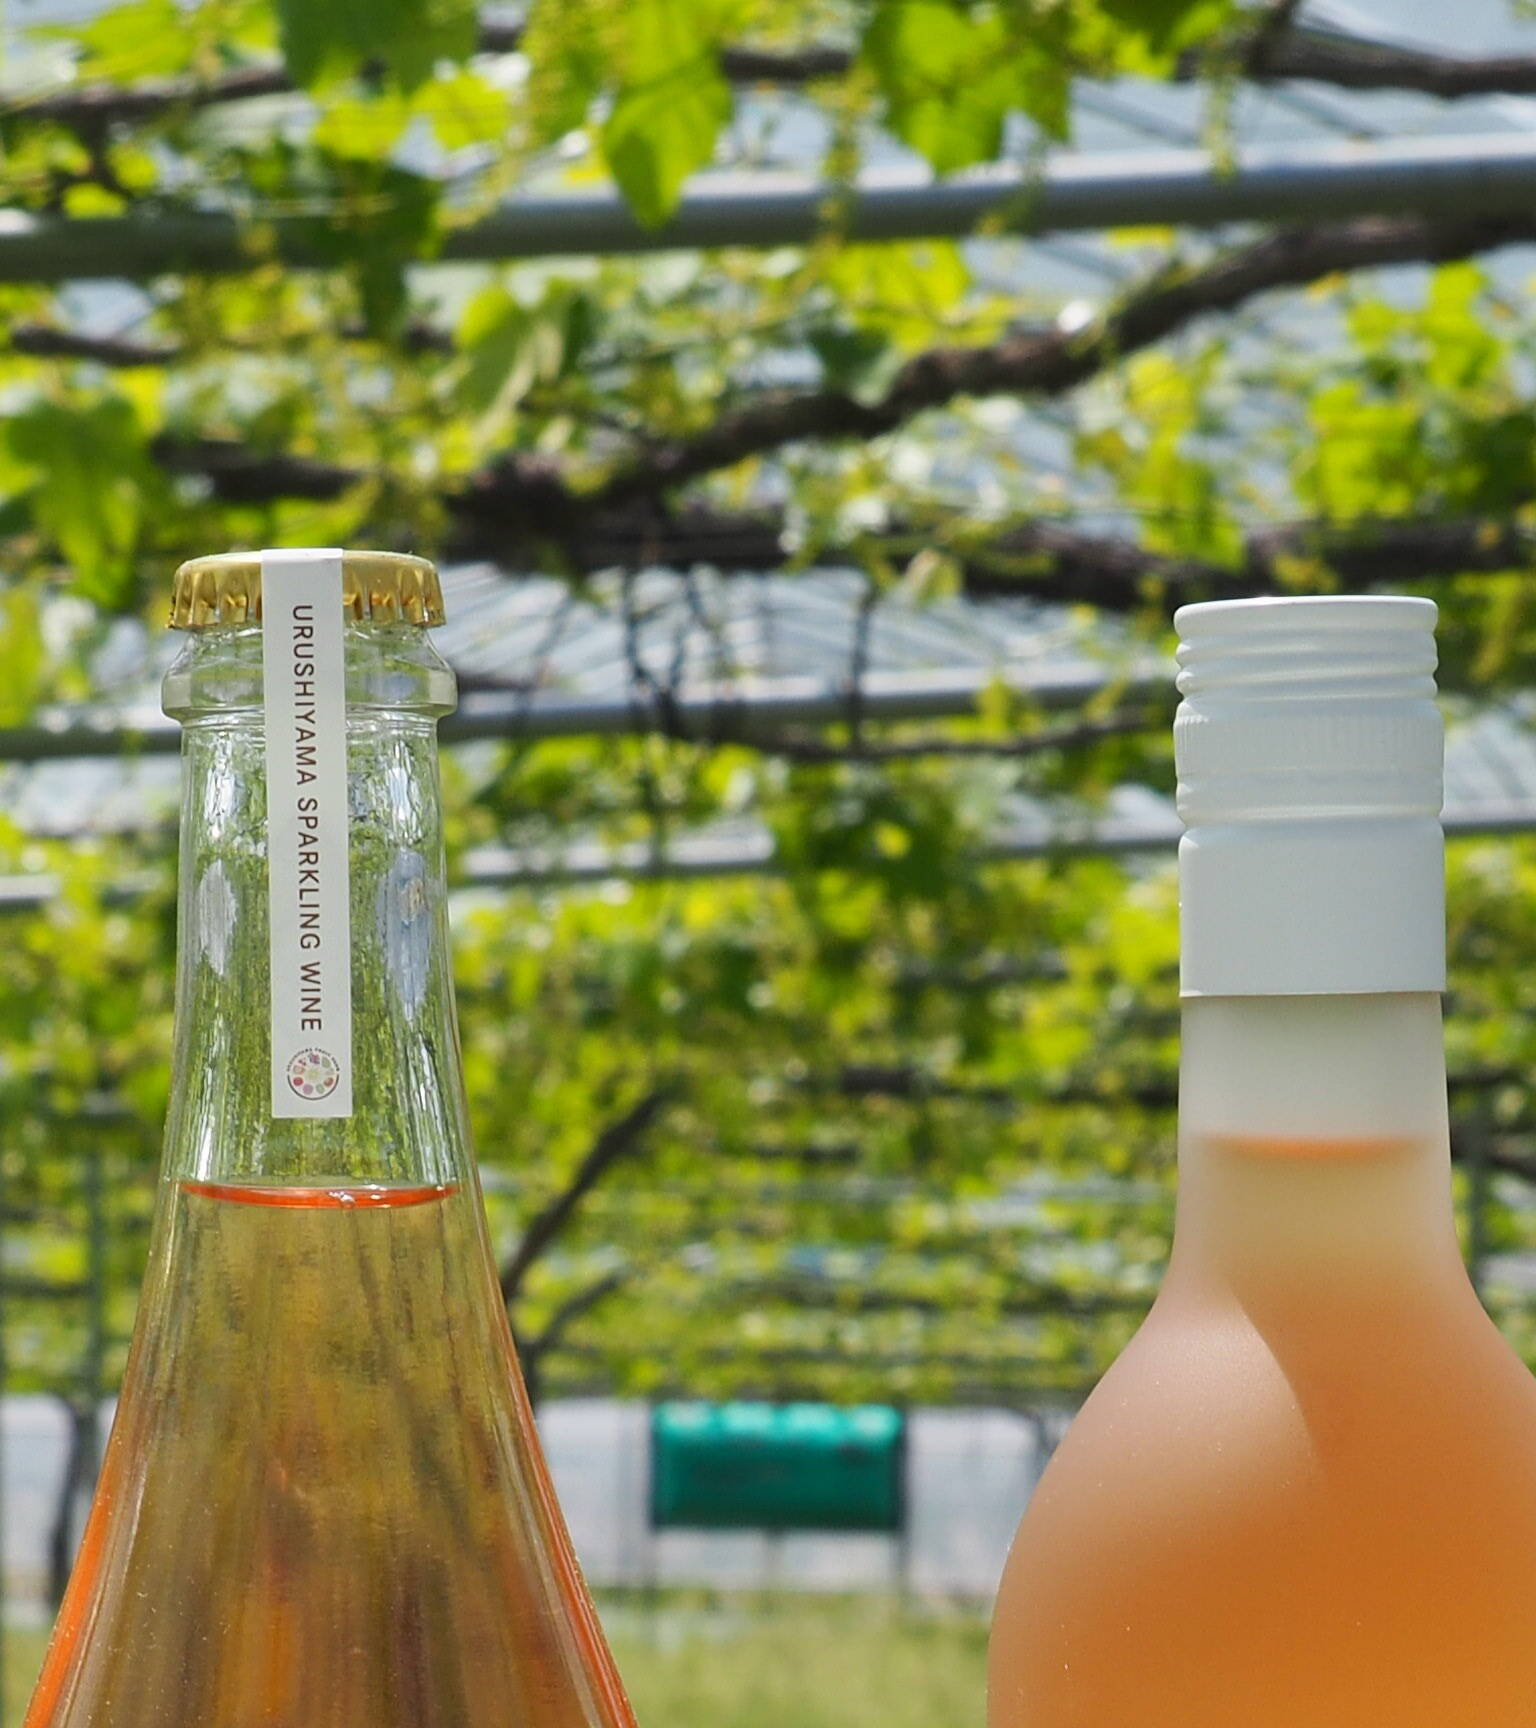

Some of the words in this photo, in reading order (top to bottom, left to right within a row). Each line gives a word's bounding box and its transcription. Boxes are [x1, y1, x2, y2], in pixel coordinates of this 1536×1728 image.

[293, 605, 317, 786] URUSHIYAMA
[297, 797, 320, 949] SPARKLING
[300, 961, 322, 1031] WINE
